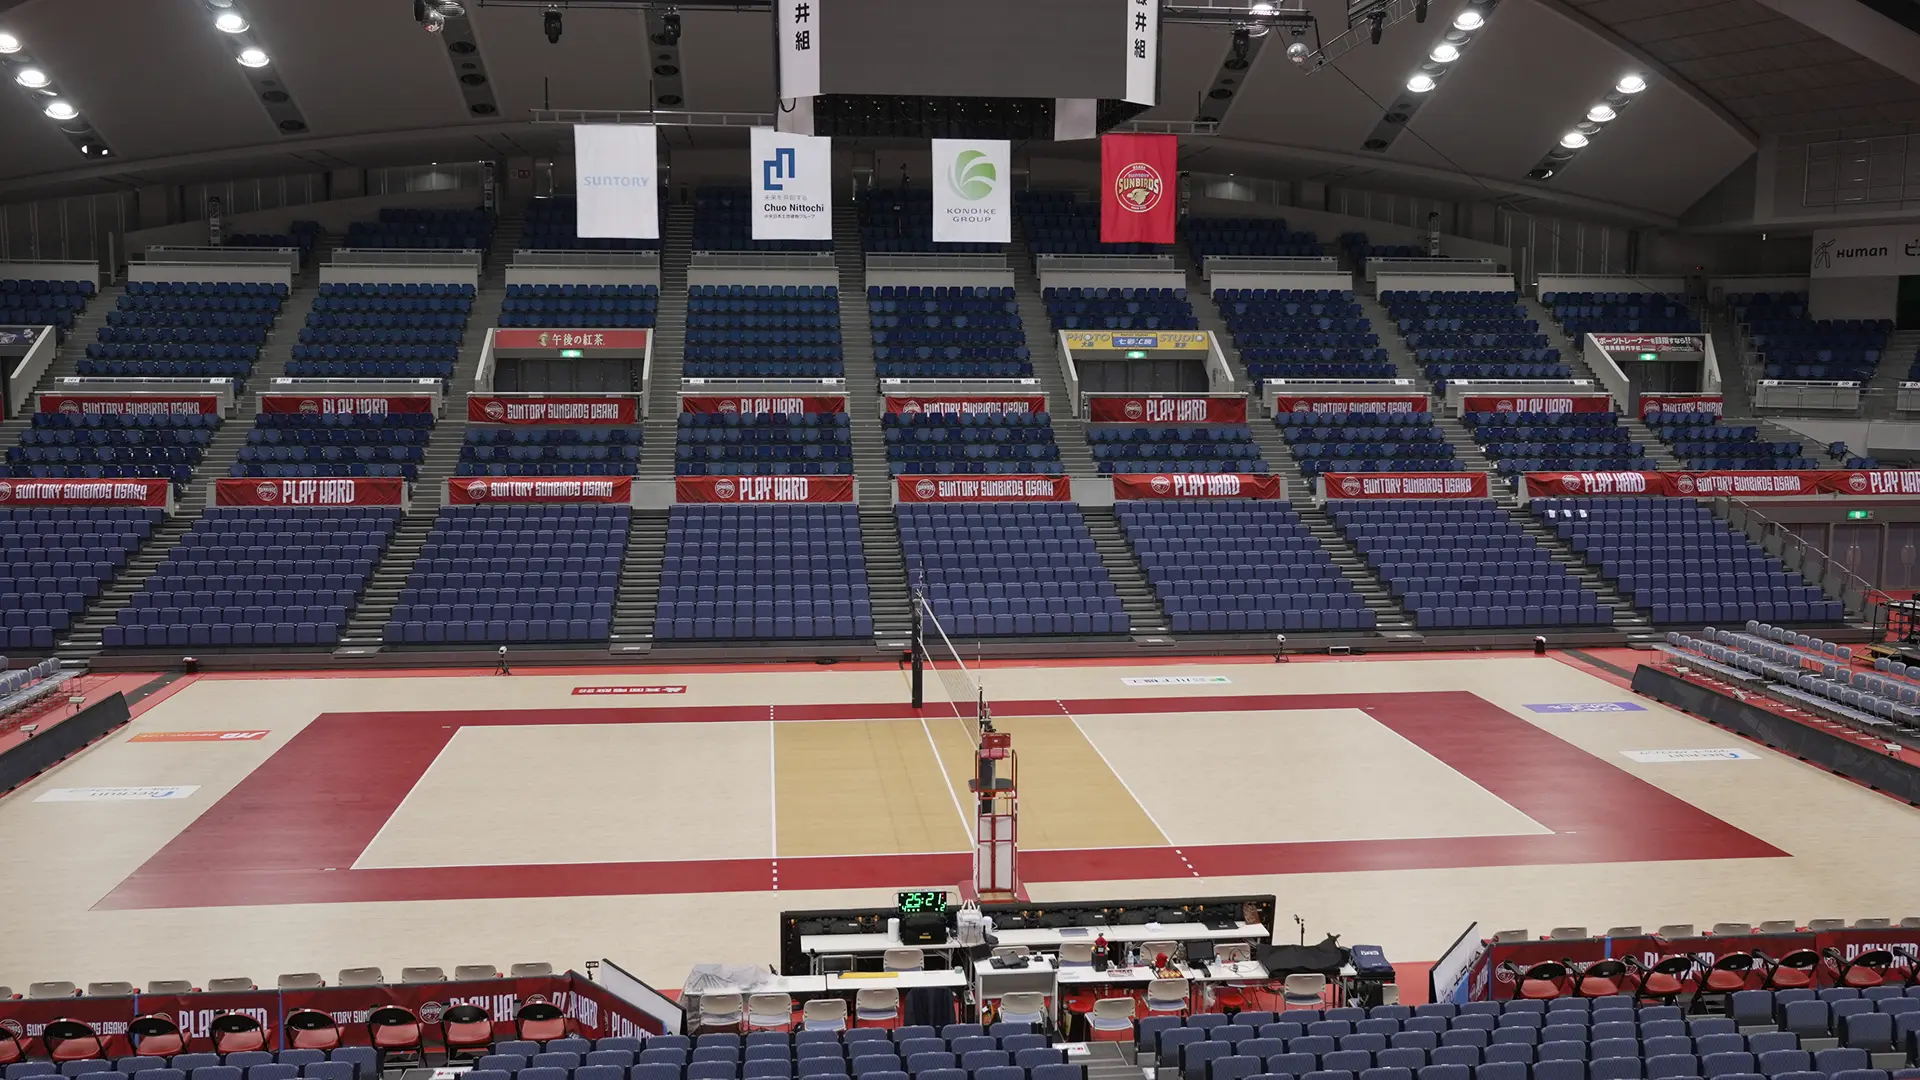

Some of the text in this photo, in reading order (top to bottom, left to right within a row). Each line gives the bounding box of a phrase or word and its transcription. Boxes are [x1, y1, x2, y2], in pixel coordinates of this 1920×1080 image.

[795, 2, 811, 51] 井組
[583, 175, 651, 187] SUNTORY
[1118, 178, 1160, 195] SUNBIRDS
[764, 203, 825, 212] Chuo Nittochi
[552, 333, 604, 346] 午後の紅茶
[1066, 333, 1111, 342] PHOTO
[1159, 333, 1206, 343] STUDIO
[507, 404, 619, 419] SUNTORY SUNBIRDS OSAKA
[1146, 399, 1207, 421] PLAY HARD
[491, 481, 613, 497] SUNTORY SUNBIRDS OSAKA
[739, 477, 808, 501] PLAY HARD
[939, 480, 1054, 497] SUNTORY SUNBIRDS OSAKA
[1173, 475, 1240, 496] PLAY HARD
[1363, 478, 1472, 494] SUNTORY SUNBIRDS OSAKA
[1582, 472, 1646, 493] PLAY HARD
[1696, 475, 1801, 491] SUNTORY SUNBIRDS OSAKA
[1869, 471, 1899, 493] PLAY
[16, 483, 147, 500] SUNTORY SUNBIRDS OSAKA
[282, 480, 354, 504] PLAY HARD
